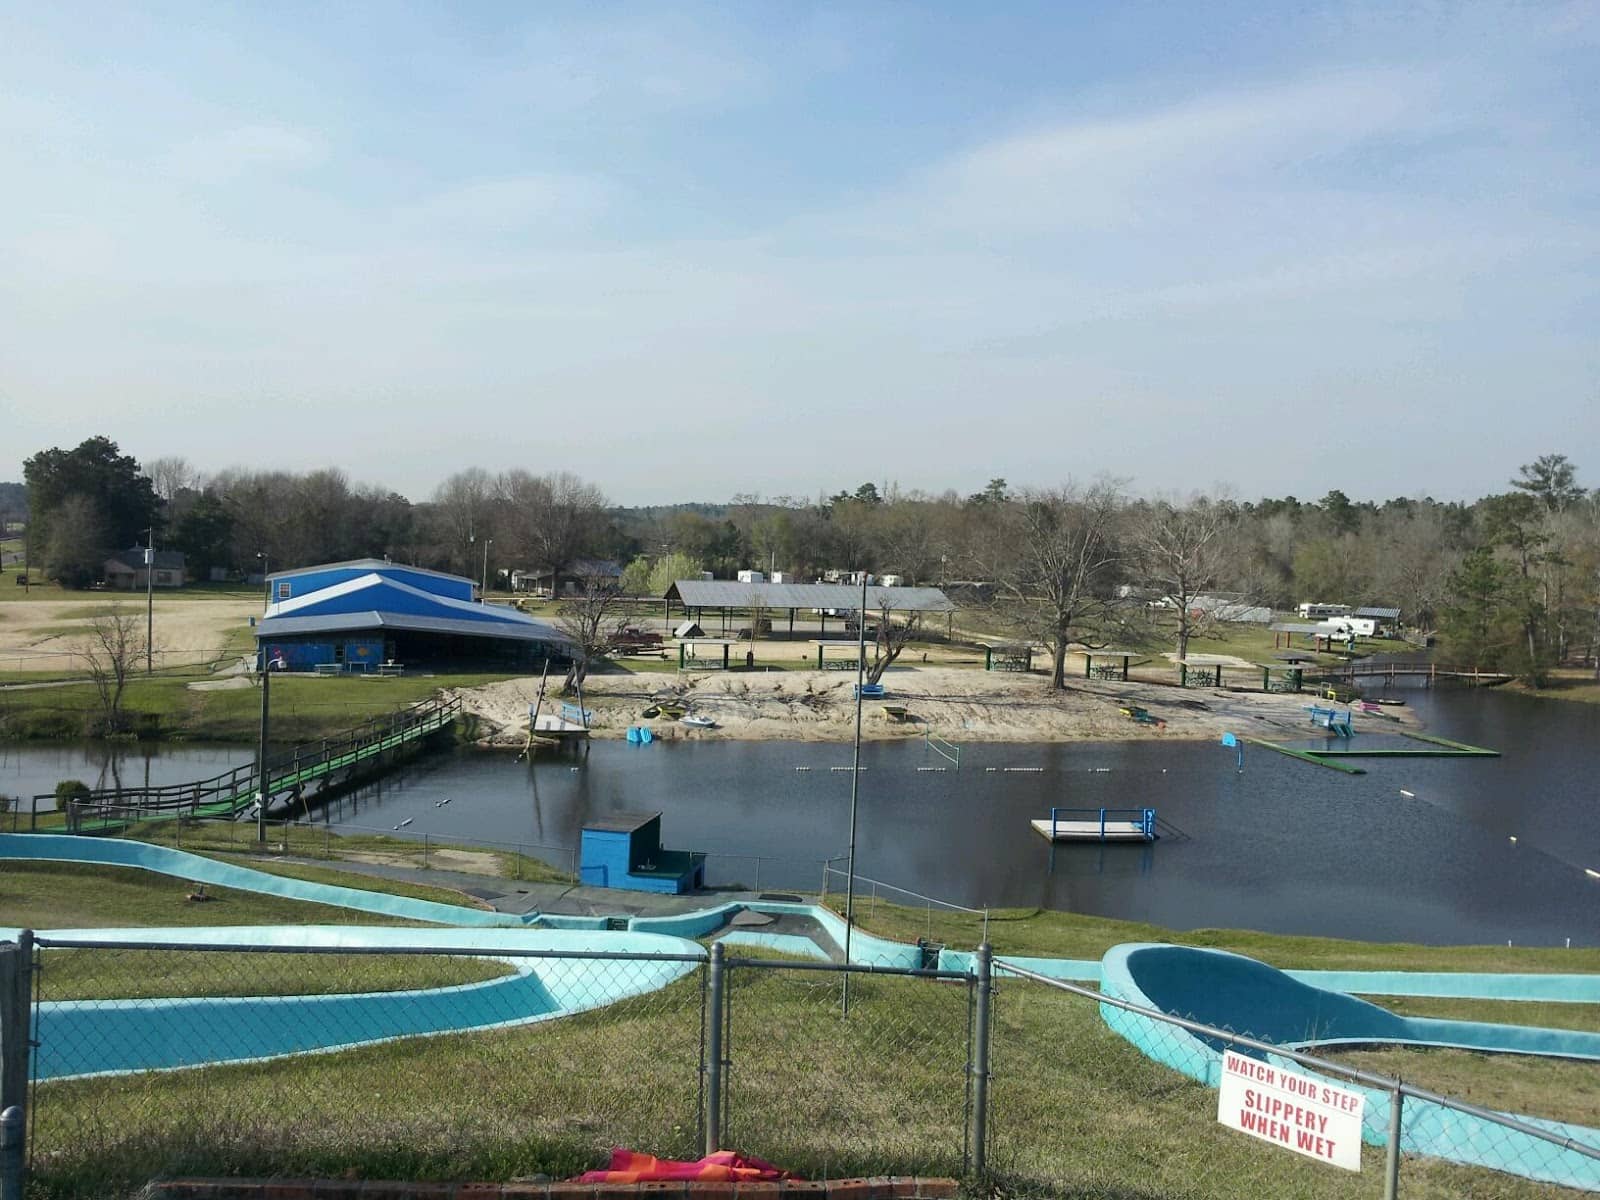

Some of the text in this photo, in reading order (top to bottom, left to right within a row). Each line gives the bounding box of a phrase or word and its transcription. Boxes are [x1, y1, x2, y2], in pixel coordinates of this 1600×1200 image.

[1227, 1055, 1358, 1112] WATCH YOUR STEP
[1240, 1109, 1336, 1158] WHEN WET
[1245, 1089, 1328, 1134] SLIPPERY
